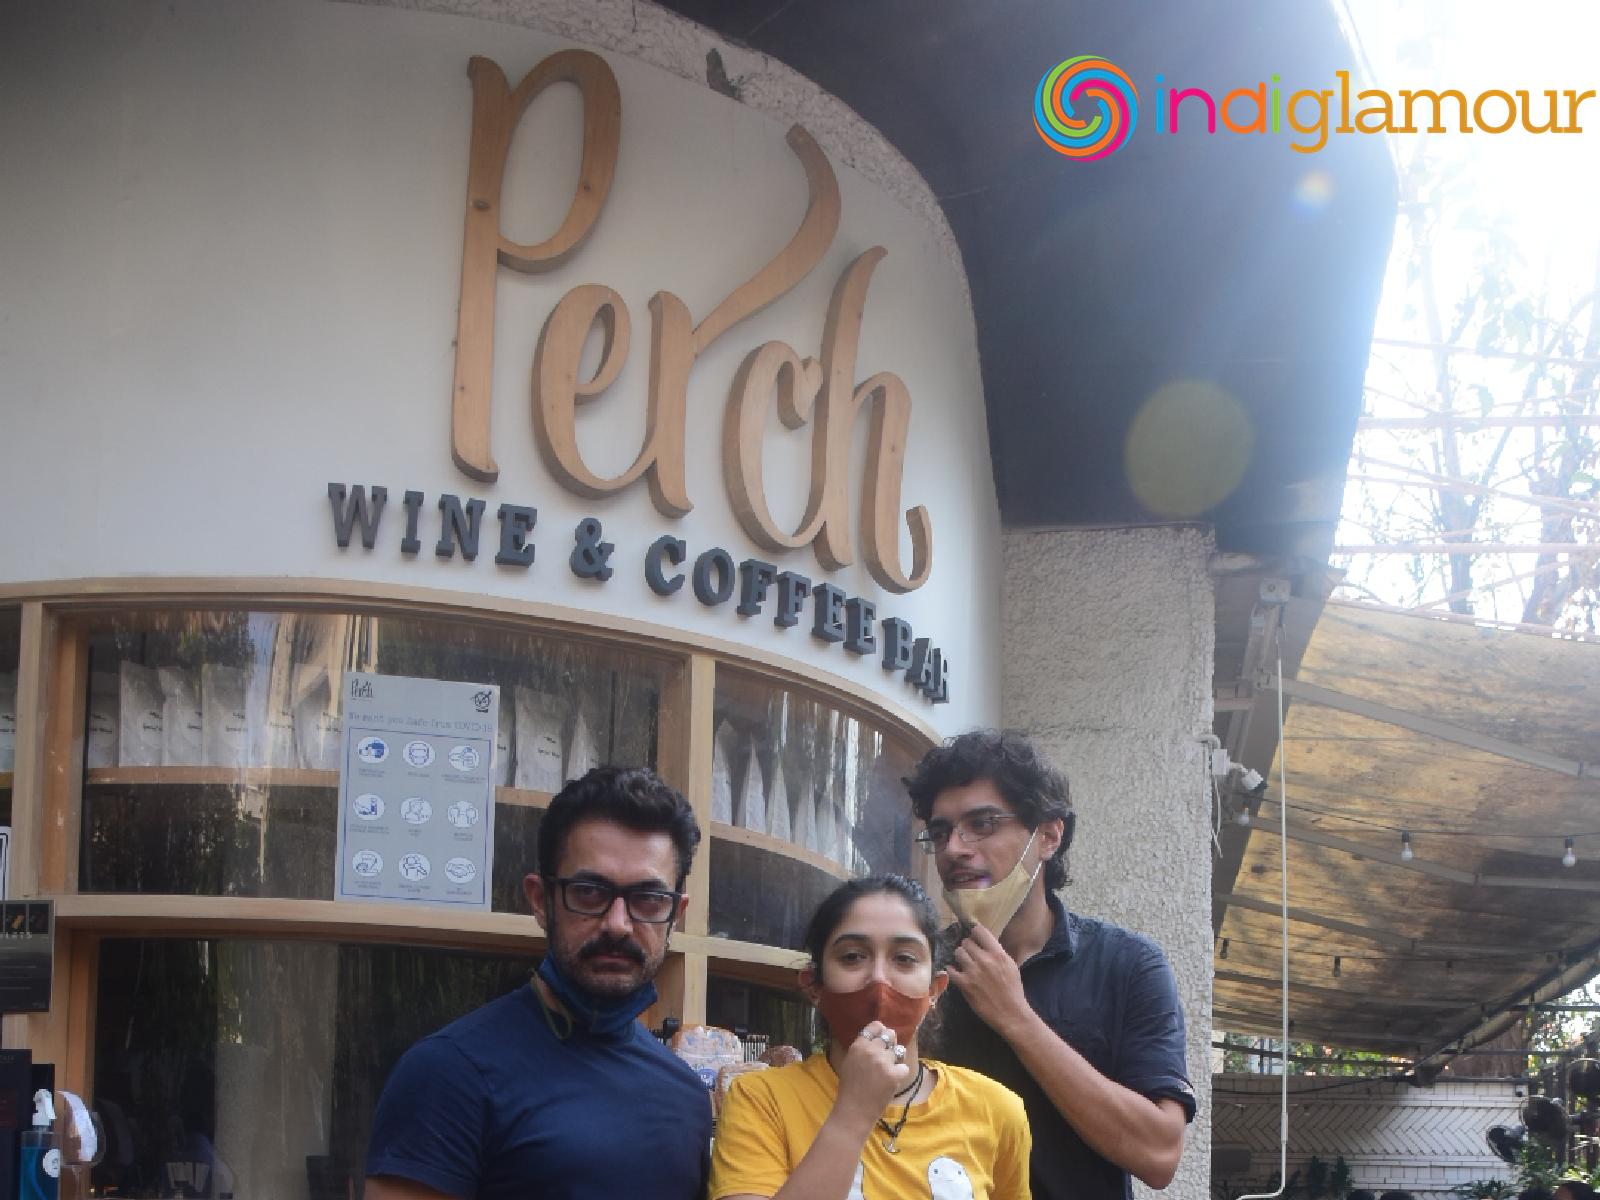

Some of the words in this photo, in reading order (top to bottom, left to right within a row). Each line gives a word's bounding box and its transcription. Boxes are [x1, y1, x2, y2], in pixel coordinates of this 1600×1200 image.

[451, 48, 933, 593] Perch
[328, 482, 537, 567] WINE
[569, 517, 613, 582] &
[644, 535, 877, 655] COFFEE
